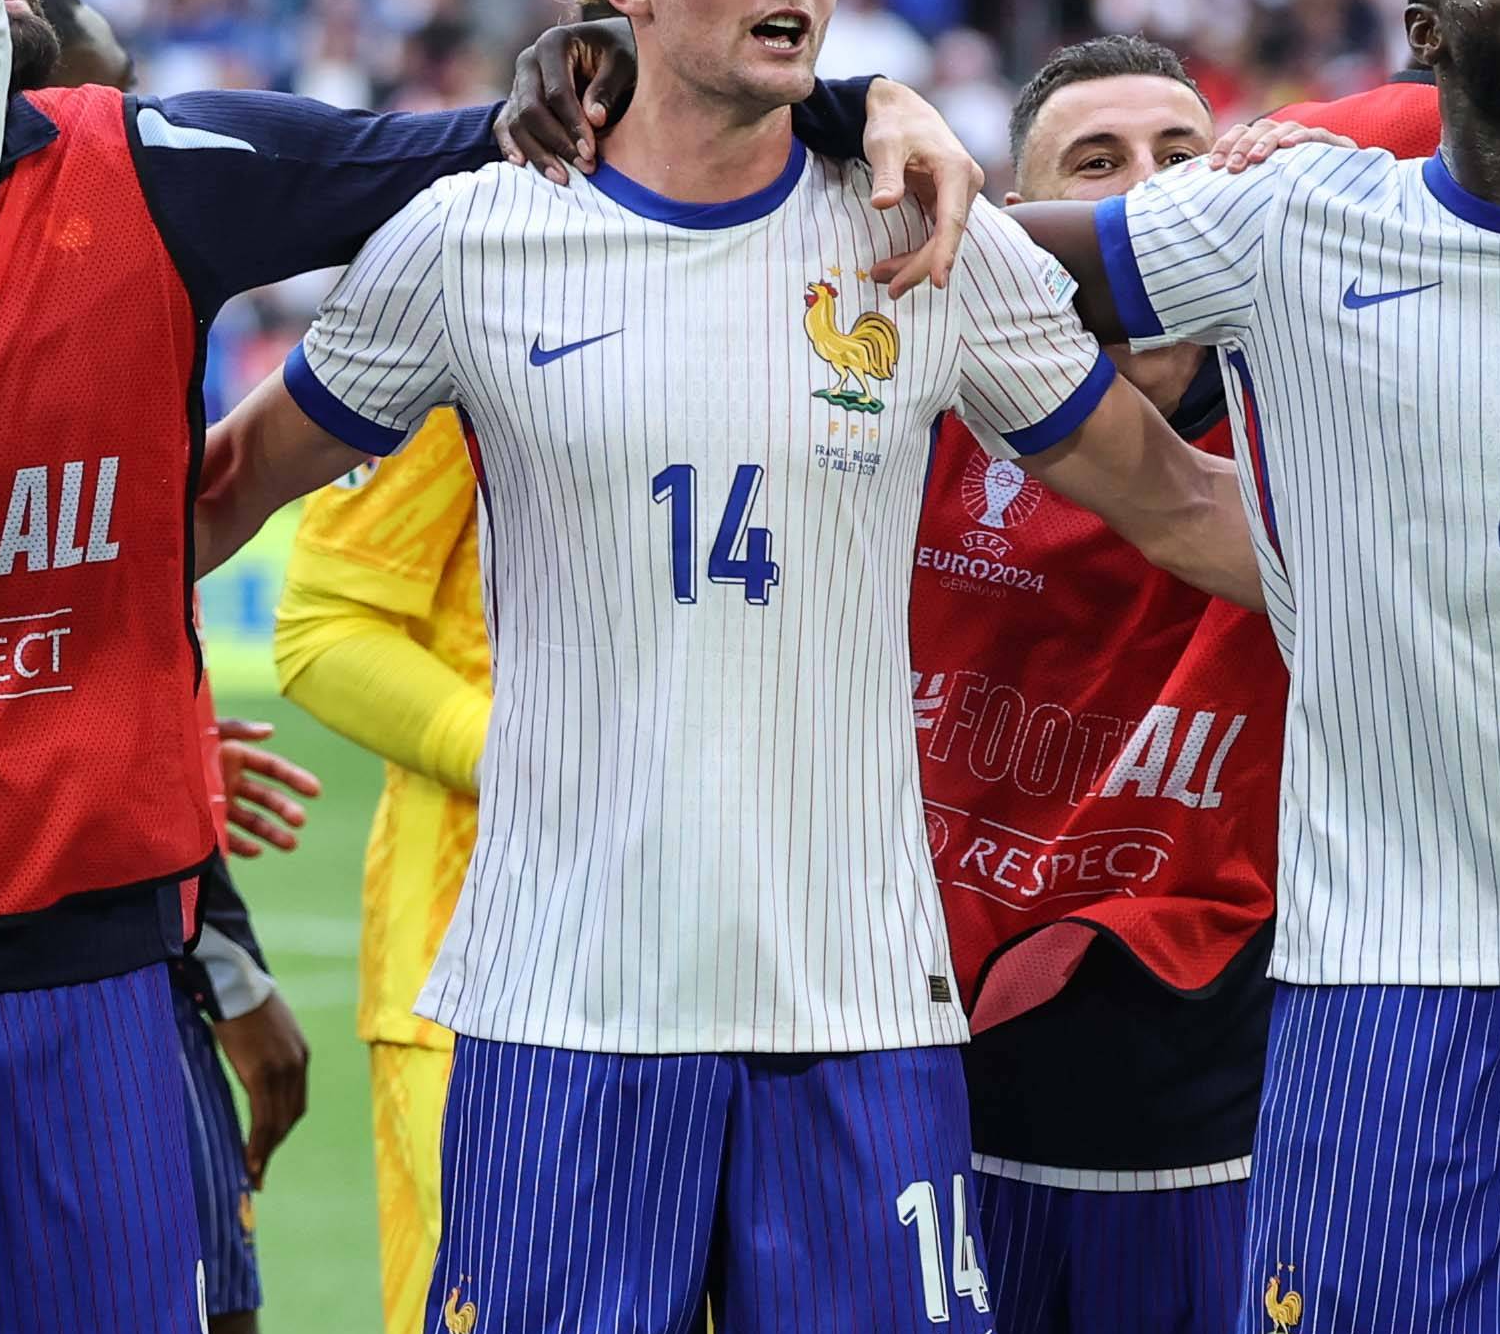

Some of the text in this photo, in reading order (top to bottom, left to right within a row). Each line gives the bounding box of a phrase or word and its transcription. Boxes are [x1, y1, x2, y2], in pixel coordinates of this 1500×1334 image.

[652, 464, 781, 606] 14
[916, 546, 1046, 595] EURO2024
[962, 534, 1008, 558] UEFA
[911, 669, 1248, 810] #FOOTALL
[958, 834, 1170, 897] RESPECT
[896, 1173, 991, 1324] 14
